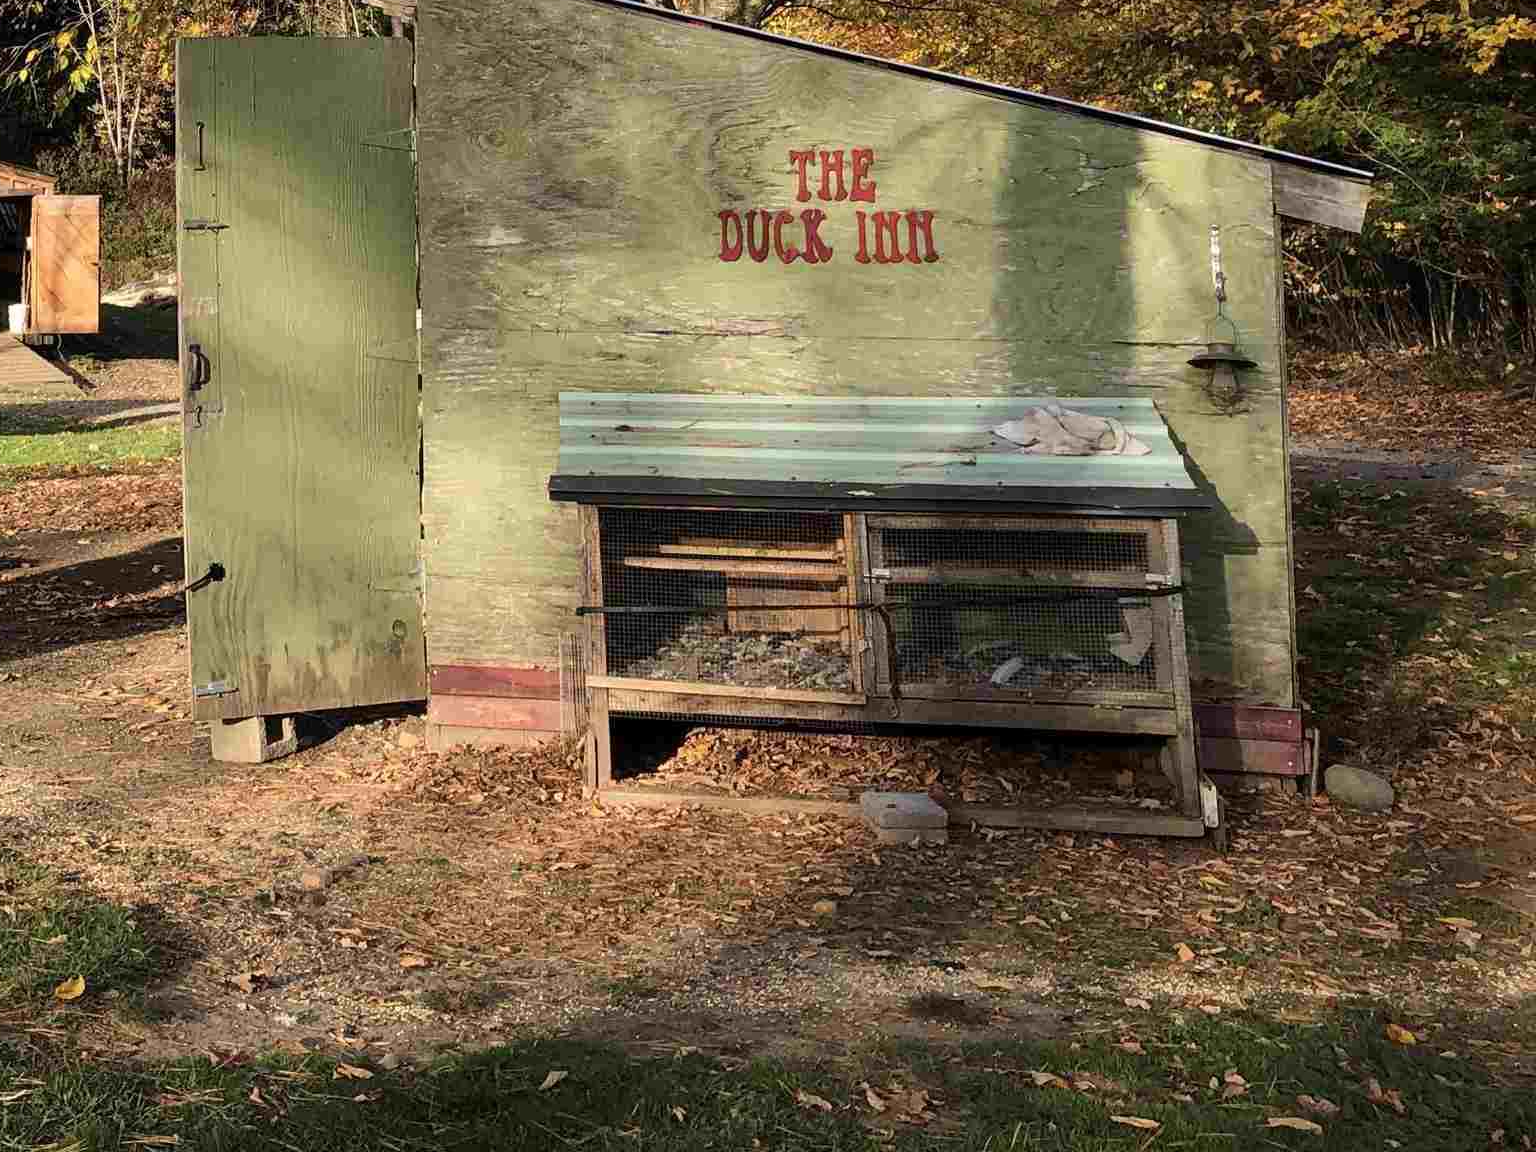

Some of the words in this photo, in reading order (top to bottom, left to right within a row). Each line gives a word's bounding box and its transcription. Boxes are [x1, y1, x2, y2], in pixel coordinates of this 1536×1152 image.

[789, 148, 877, 202] THE
[718, 208, 833, 263] DUCK
[855, 209, 940, 263] INN
